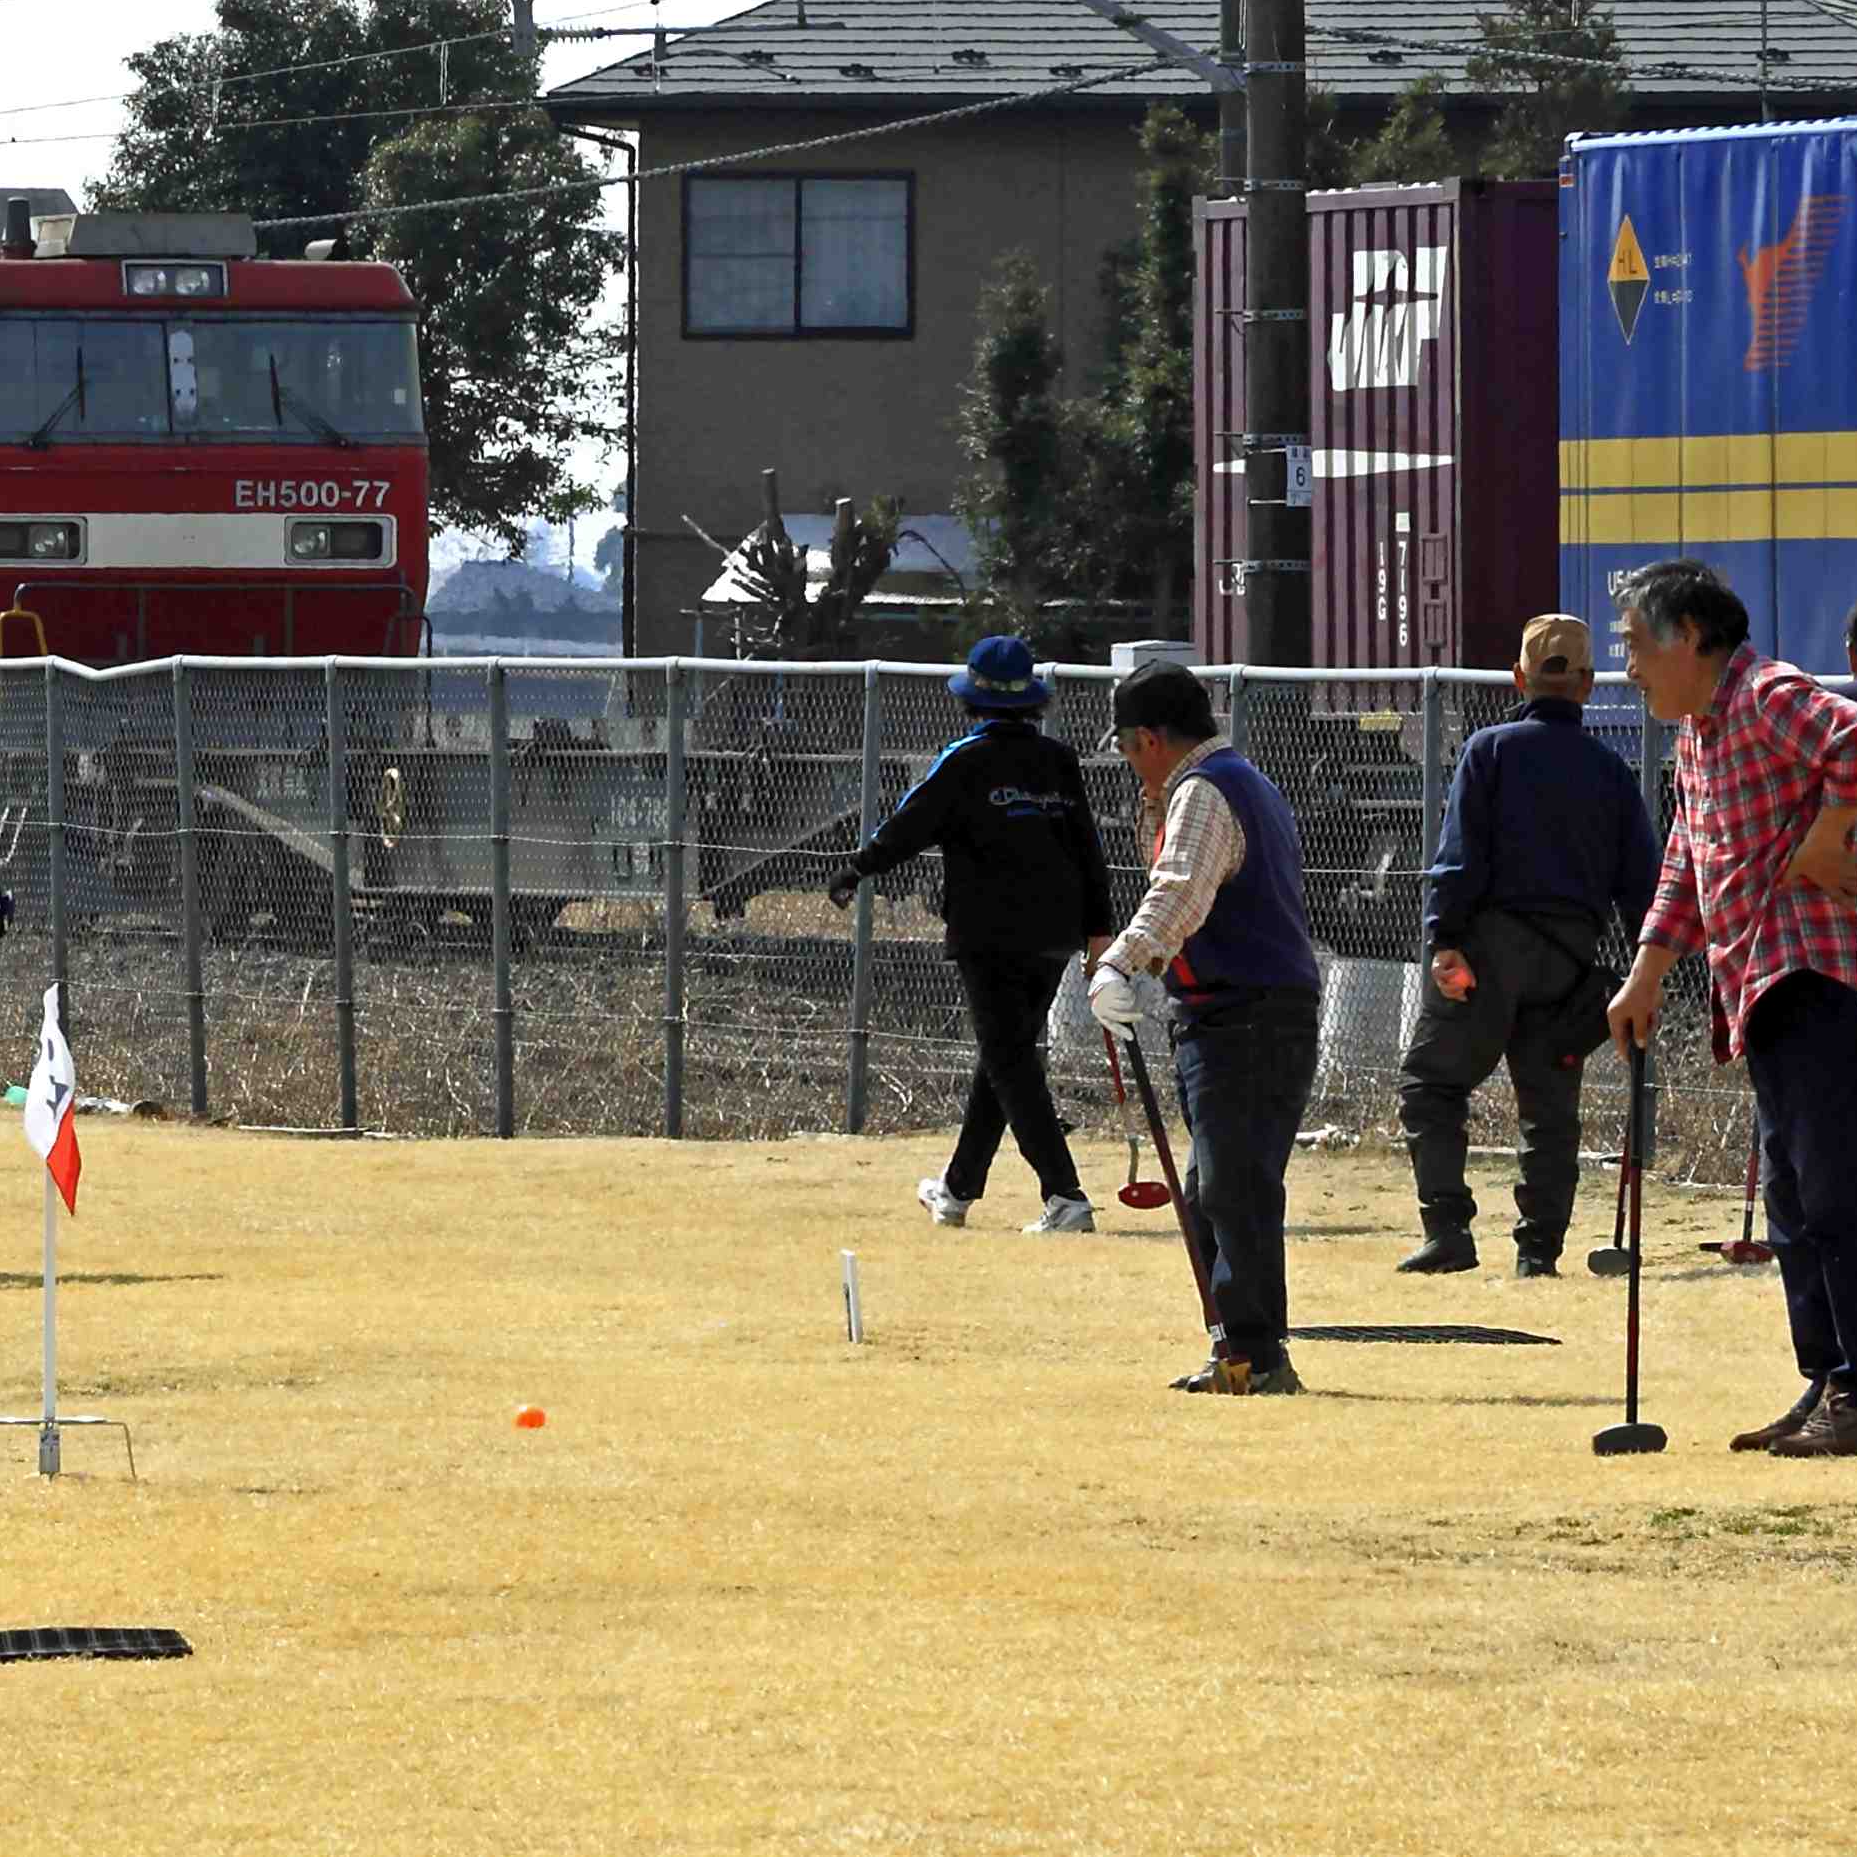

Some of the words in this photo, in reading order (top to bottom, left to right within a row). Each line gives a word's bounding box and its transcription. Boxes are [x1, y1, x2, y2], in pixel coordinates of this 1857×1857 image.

[1327, 246, 1447, 391] JRF
[1296, 466, 1306, 487] 6
[236, 479, 391, 508] EH500-77
